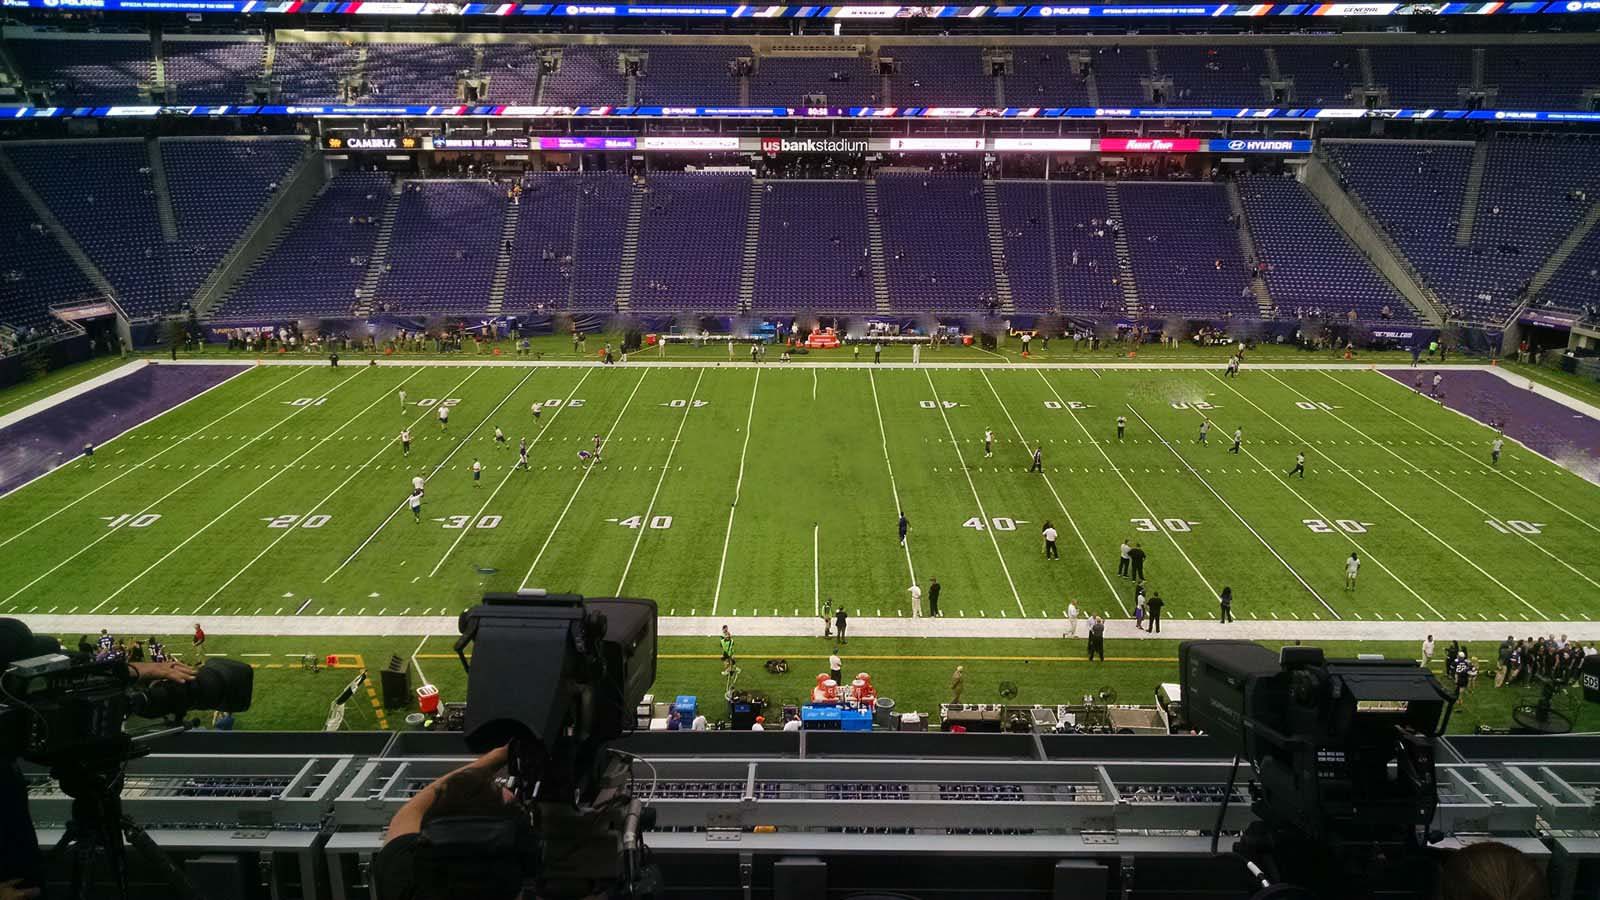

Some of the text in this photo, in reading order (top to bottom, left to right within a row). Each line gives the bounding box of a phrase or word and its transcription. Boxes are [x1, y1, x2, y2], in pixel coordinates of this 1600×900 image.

[347, 138, 397, 148] CAMBRIA
[1247, 141, 1293, 150] HYUNDAI
[107, 514, 162, 528] 10
[267, 515, 332, 528] 20
[442, 515, 503, 529] 30
[619, 515, 673, 529] 40
[962, 517, 1017, 531] 40
[1130, 518, 1192, 532] 30
[1302, 519, 1368, 533] 20
[1484, 520, 1542, 534] 10
